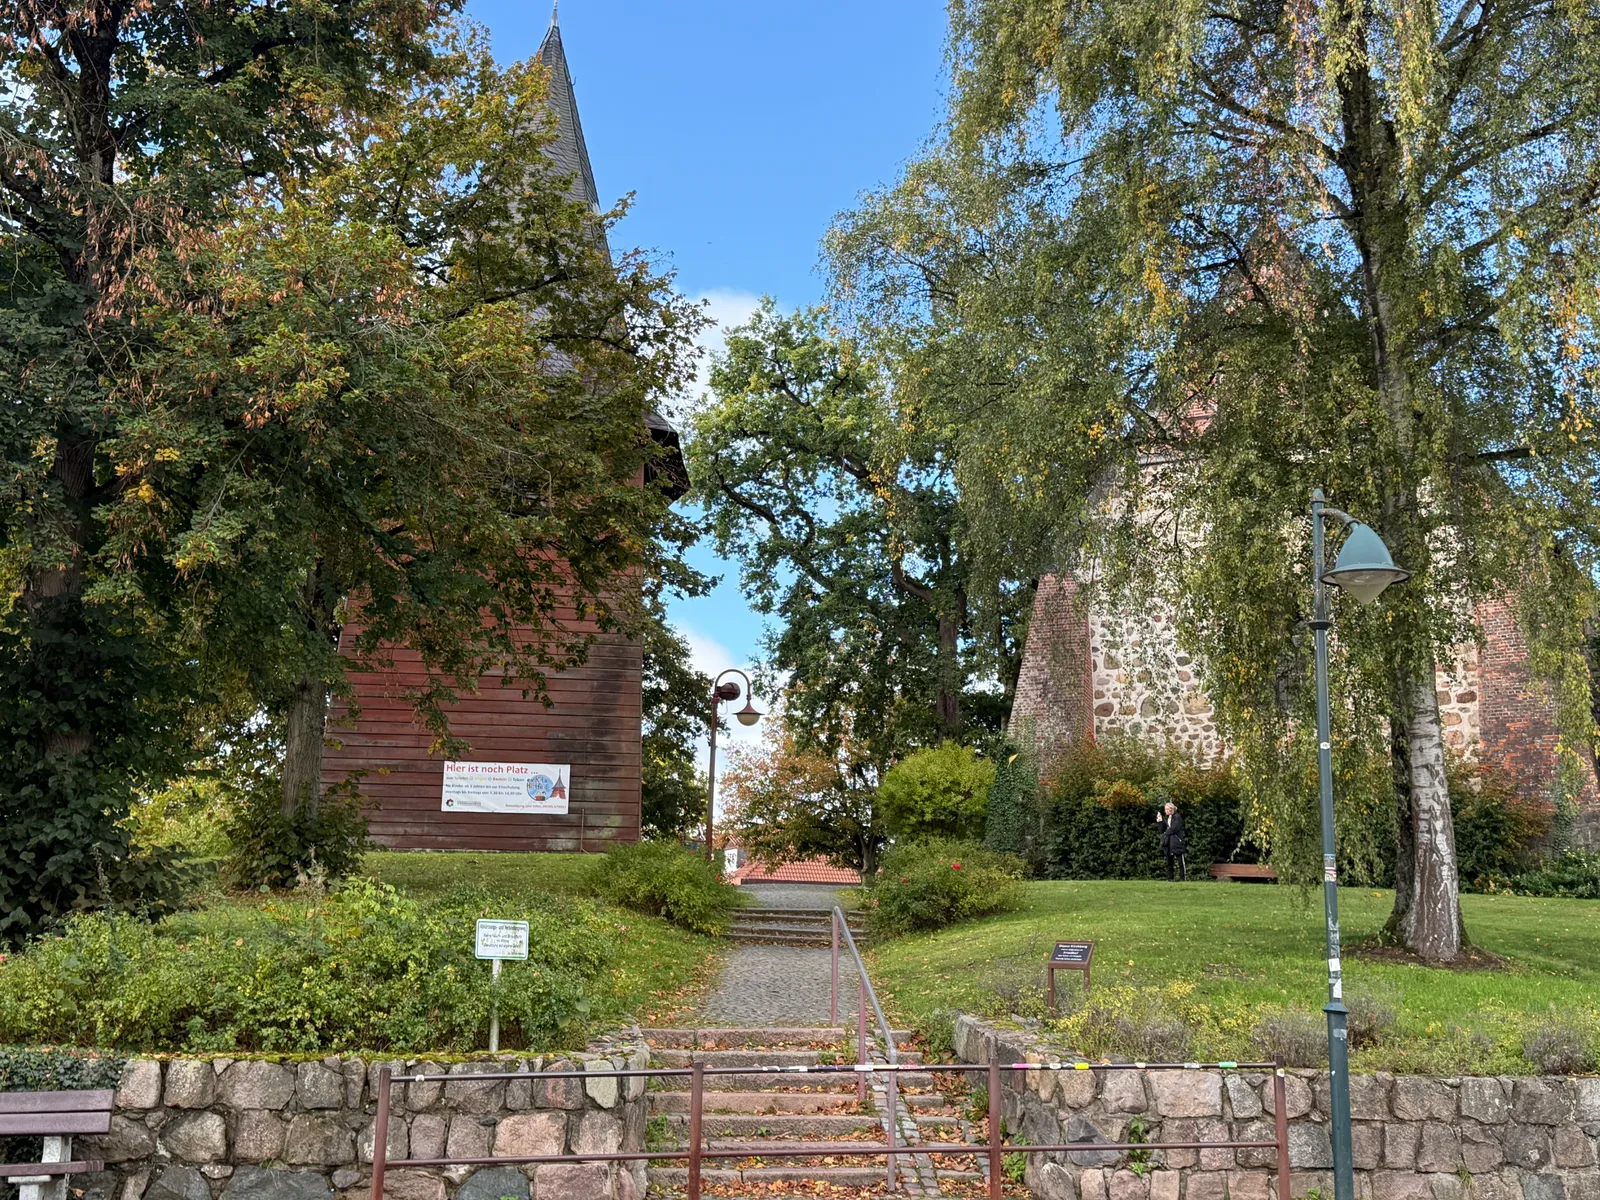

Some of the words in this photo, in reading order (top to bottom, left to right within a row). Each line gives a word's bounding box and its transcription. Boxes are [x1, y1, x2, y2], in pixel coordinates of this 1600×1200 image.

[446, 764, 466, 772] Hier
[468, 764, 479, 772] ist
[482, 765, 504, 773] noch
[506, 766, 528, 774] Platz
